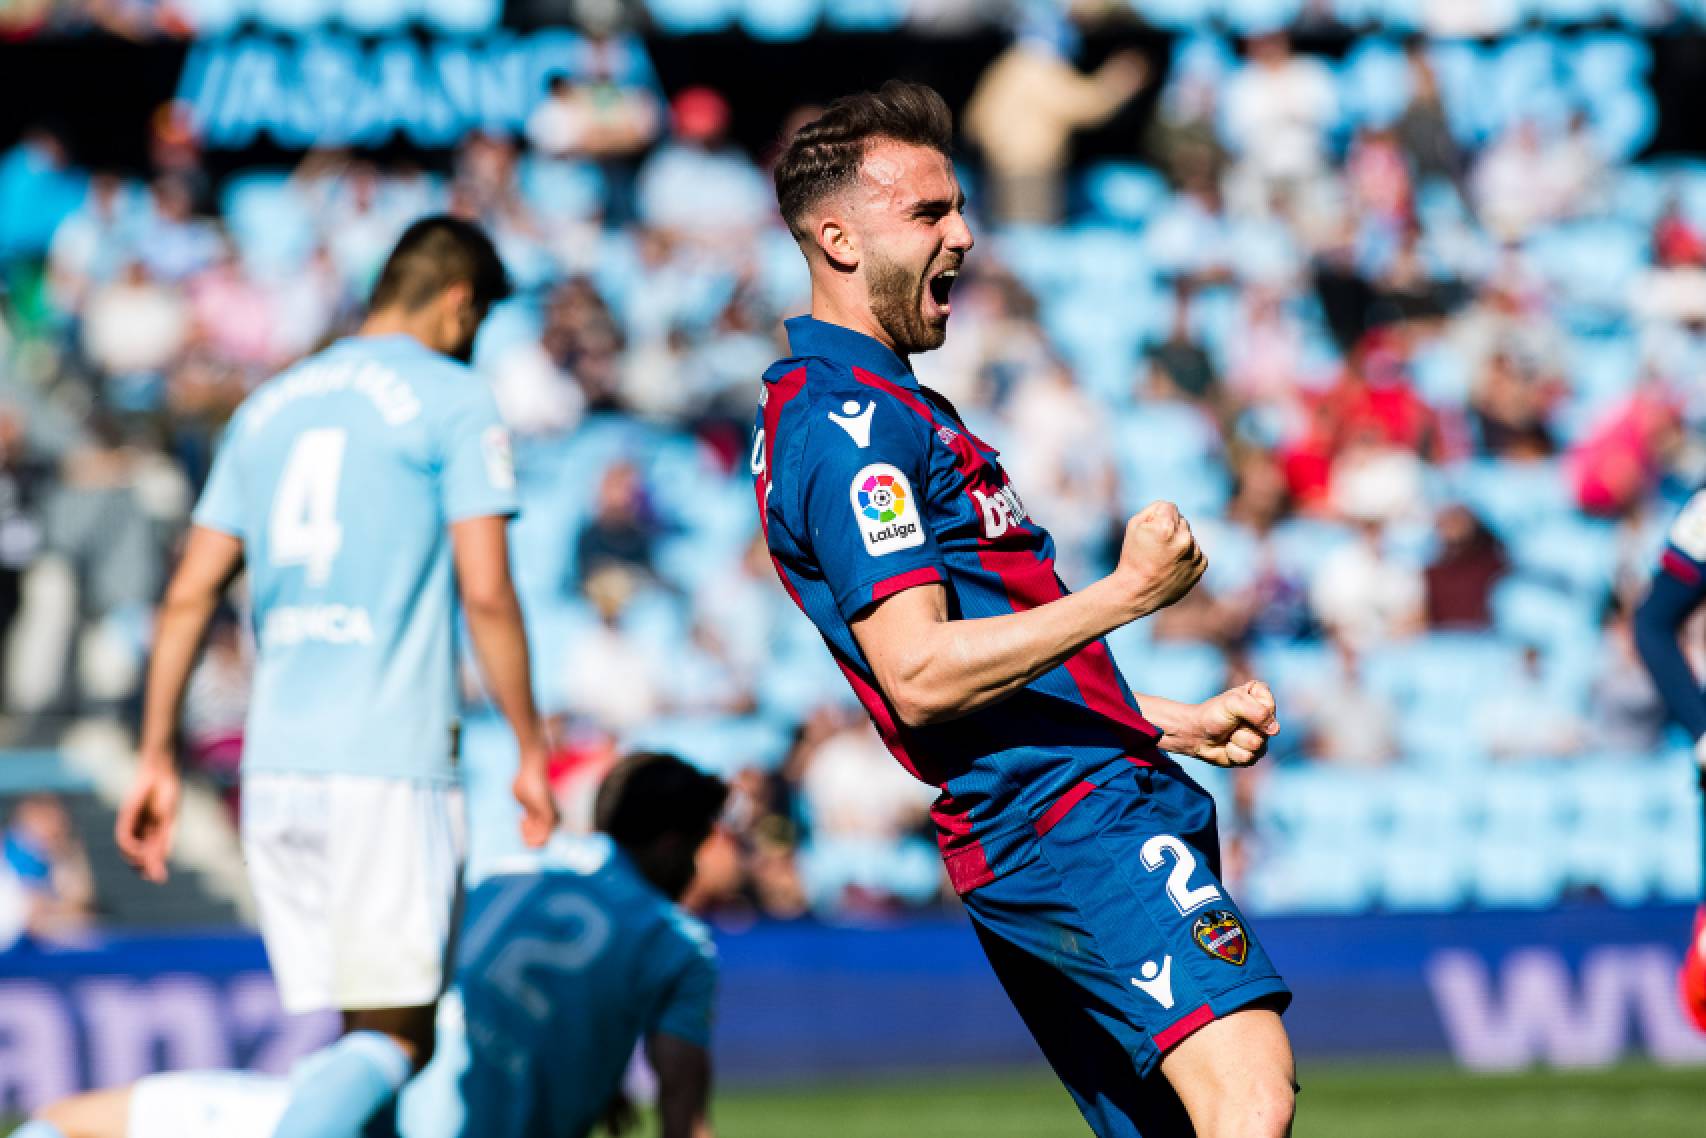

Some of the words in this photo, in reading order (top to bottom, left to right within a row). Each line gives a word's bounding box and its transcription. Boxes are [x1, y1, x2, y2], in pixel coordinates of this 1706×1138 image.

[267, 428, 346, 589] 4
[868, 522, 917, 544] LaLiga
[1140, 834, 1222, 917] 2
